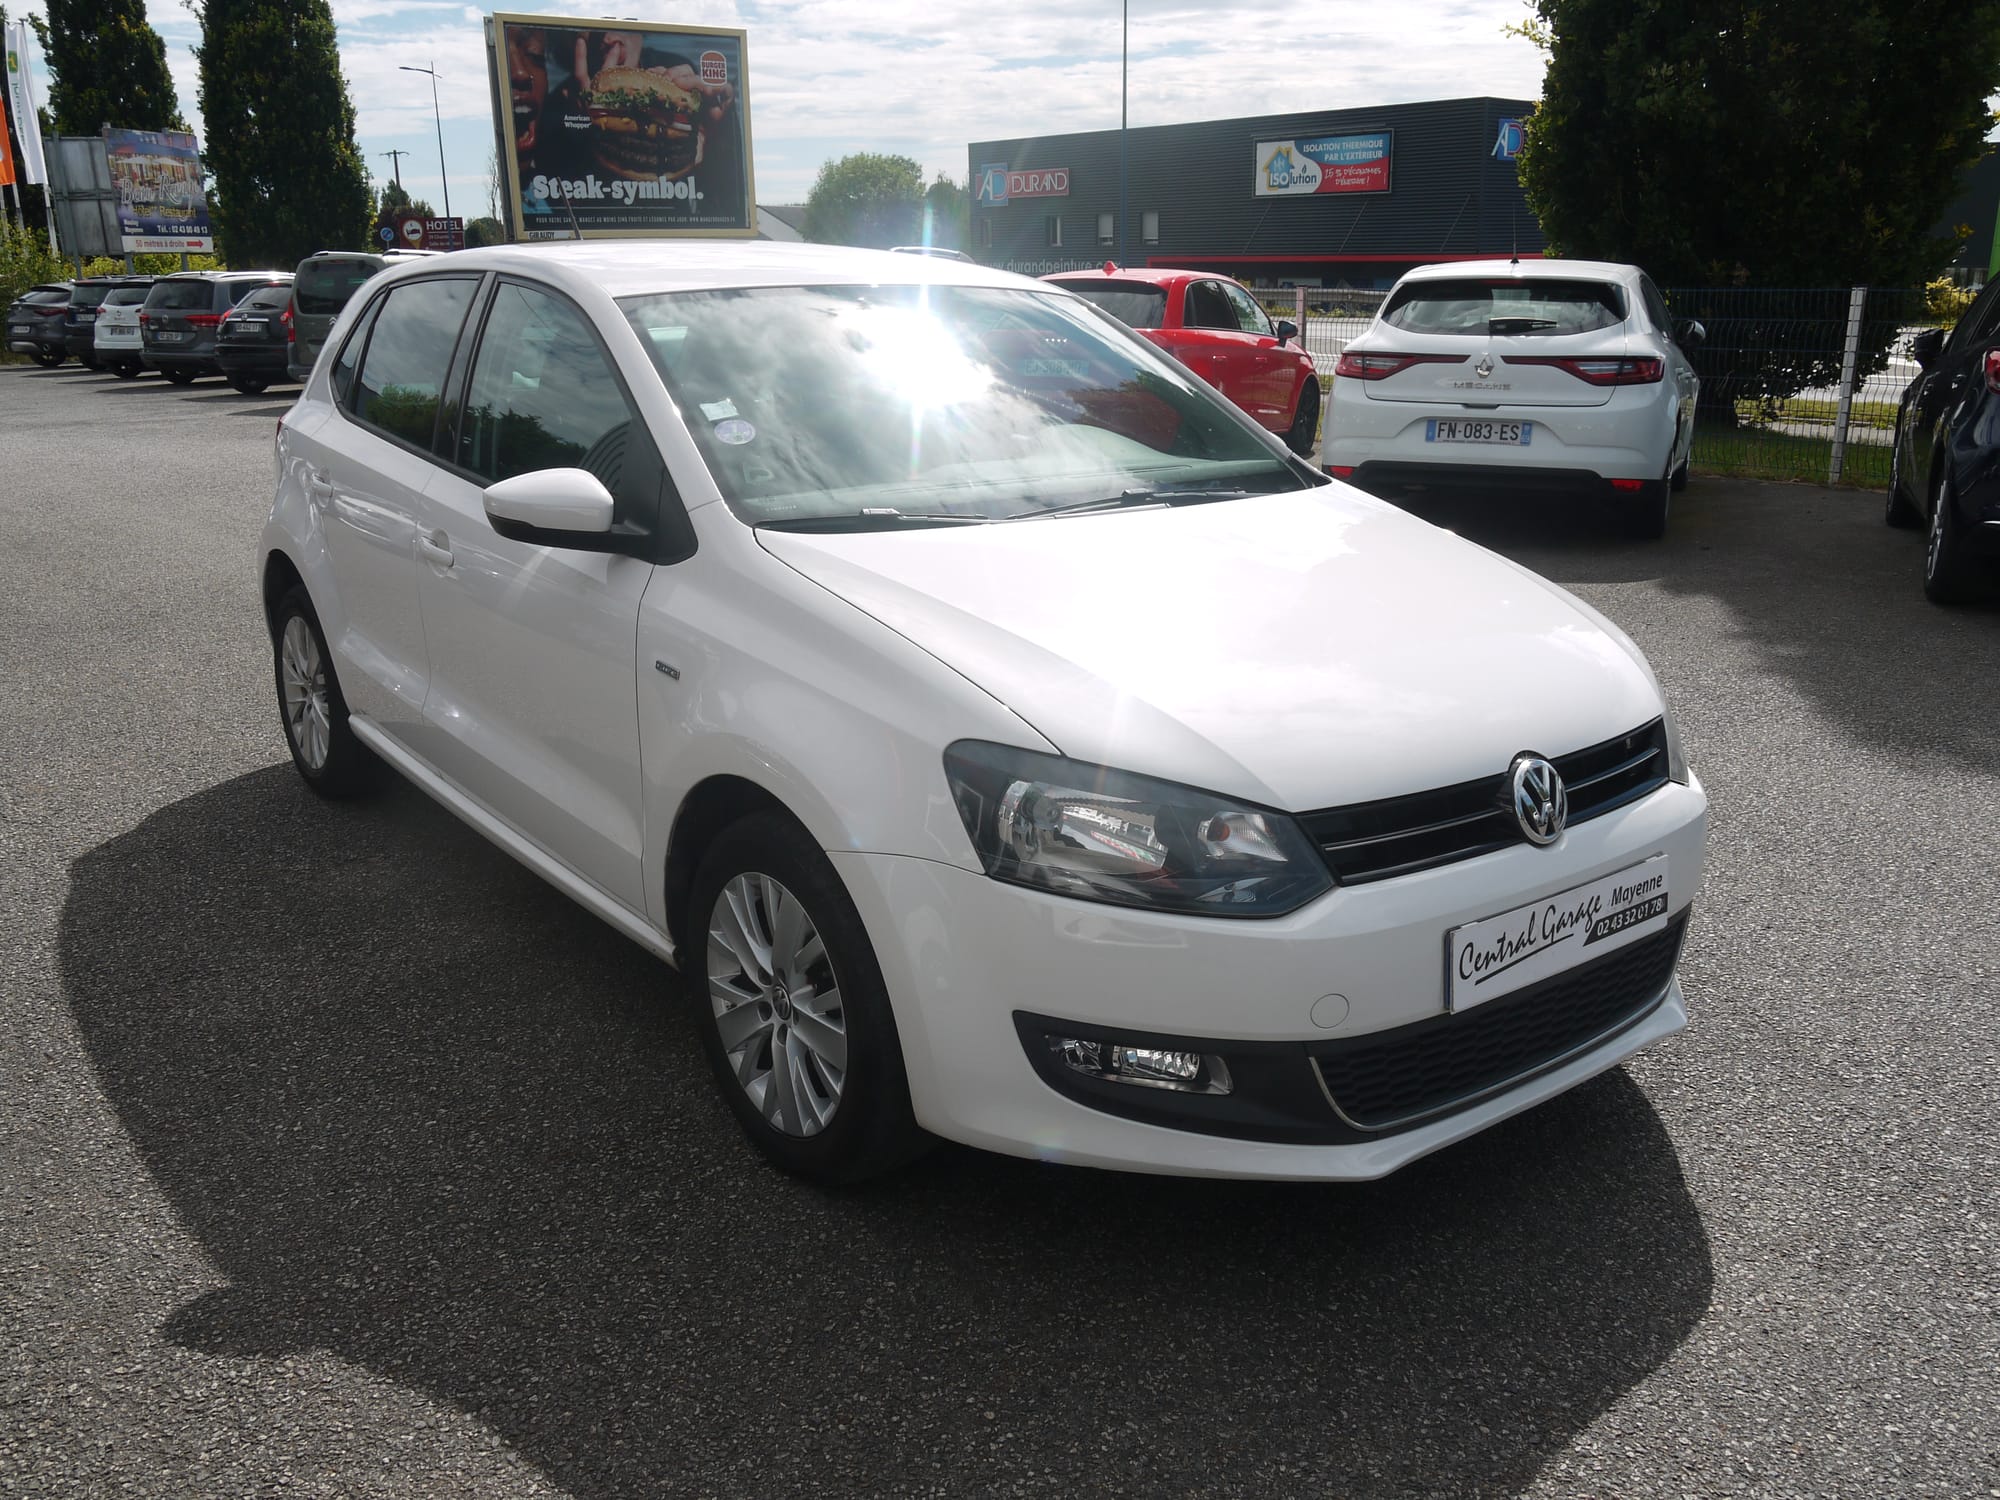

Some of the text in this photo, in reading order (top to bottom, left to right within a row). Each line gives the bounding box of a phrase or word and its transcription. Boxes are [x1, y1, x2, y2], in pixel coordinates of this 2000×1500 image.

[702, 61, 726, 69] BURGER
[703, 69, 726, 78] KING
[1303, 139, 1384, 153] ISOLATION THERMIQUE
[1491, 122, 1525, 157] AD
[1324, 150, 1383, 161] PAR L'EXTÉRIEUR
[533, 174, 704, 205] Steak-symbol.
[1011, 172, 1068, 193] DURAND
[425, 220, 461, 231] HOTEL
[1437, 422, 1520, 441] FN-083-ES
[1597, 897, 1662, 936] 02 43 32 01 78
[1459, 874, 1663, 980] Central Garage Mayenne
